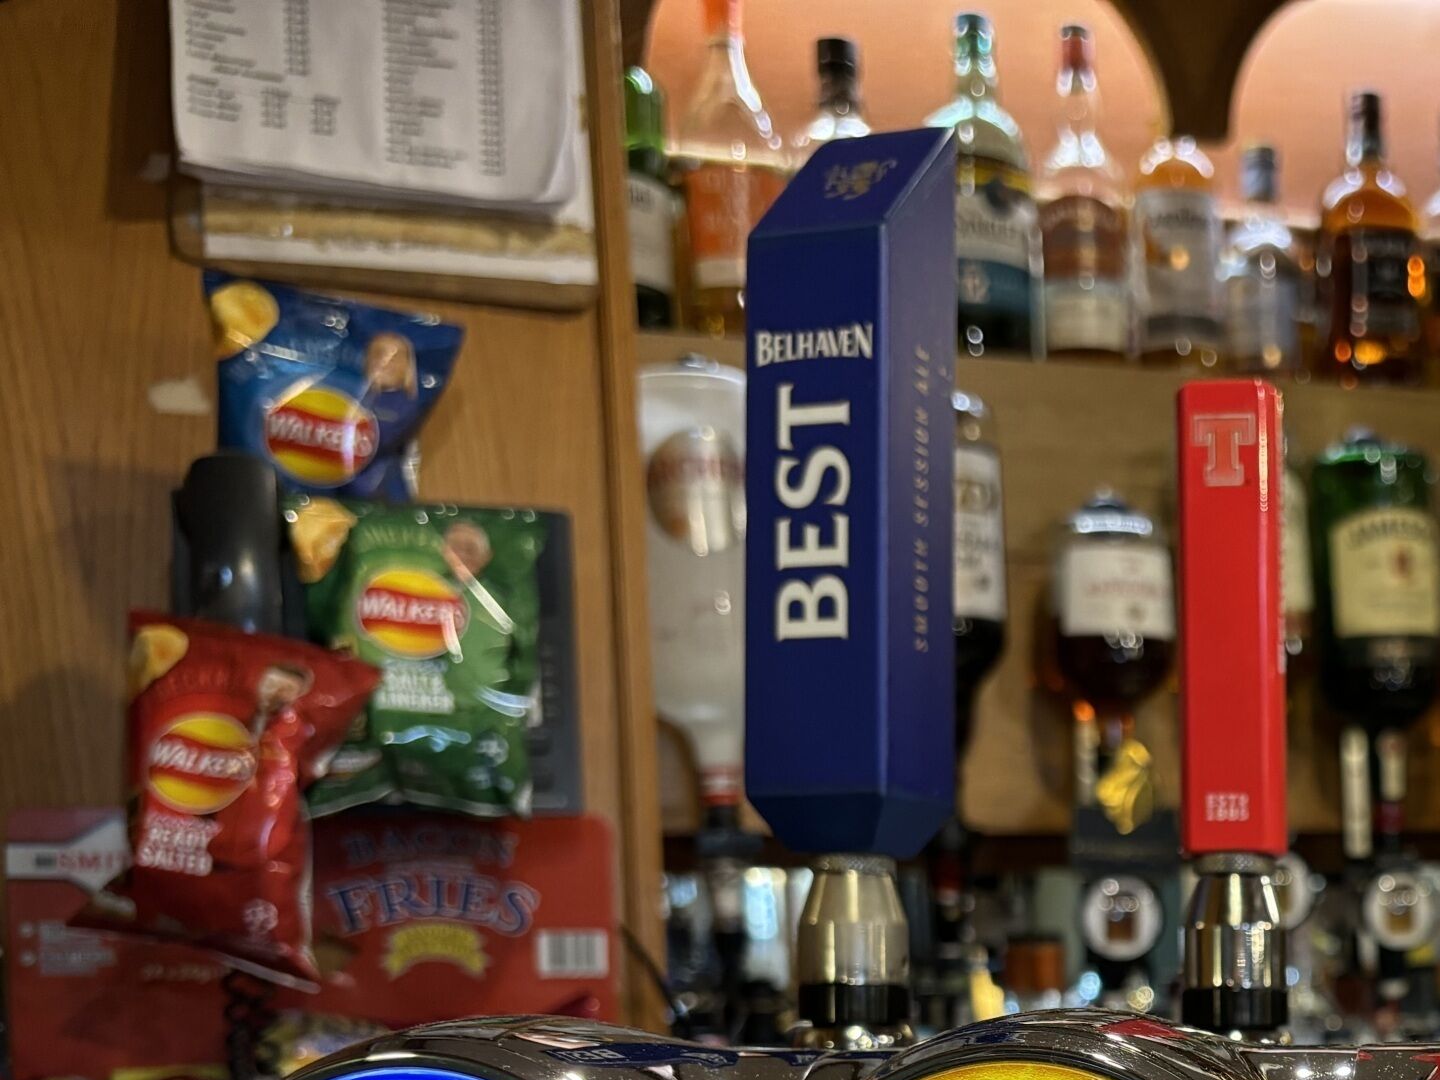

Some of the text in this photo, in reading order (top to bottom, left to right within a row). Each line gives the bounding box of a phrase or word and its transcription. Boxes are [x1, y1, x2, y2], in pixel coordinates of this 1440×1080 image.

[755, 323, 873, 367] BELHAVEN
[1193, 413, 1256, 487] T
[775, 383, 851, 641] BEST
[327, 867, 542, 938] FRIES
